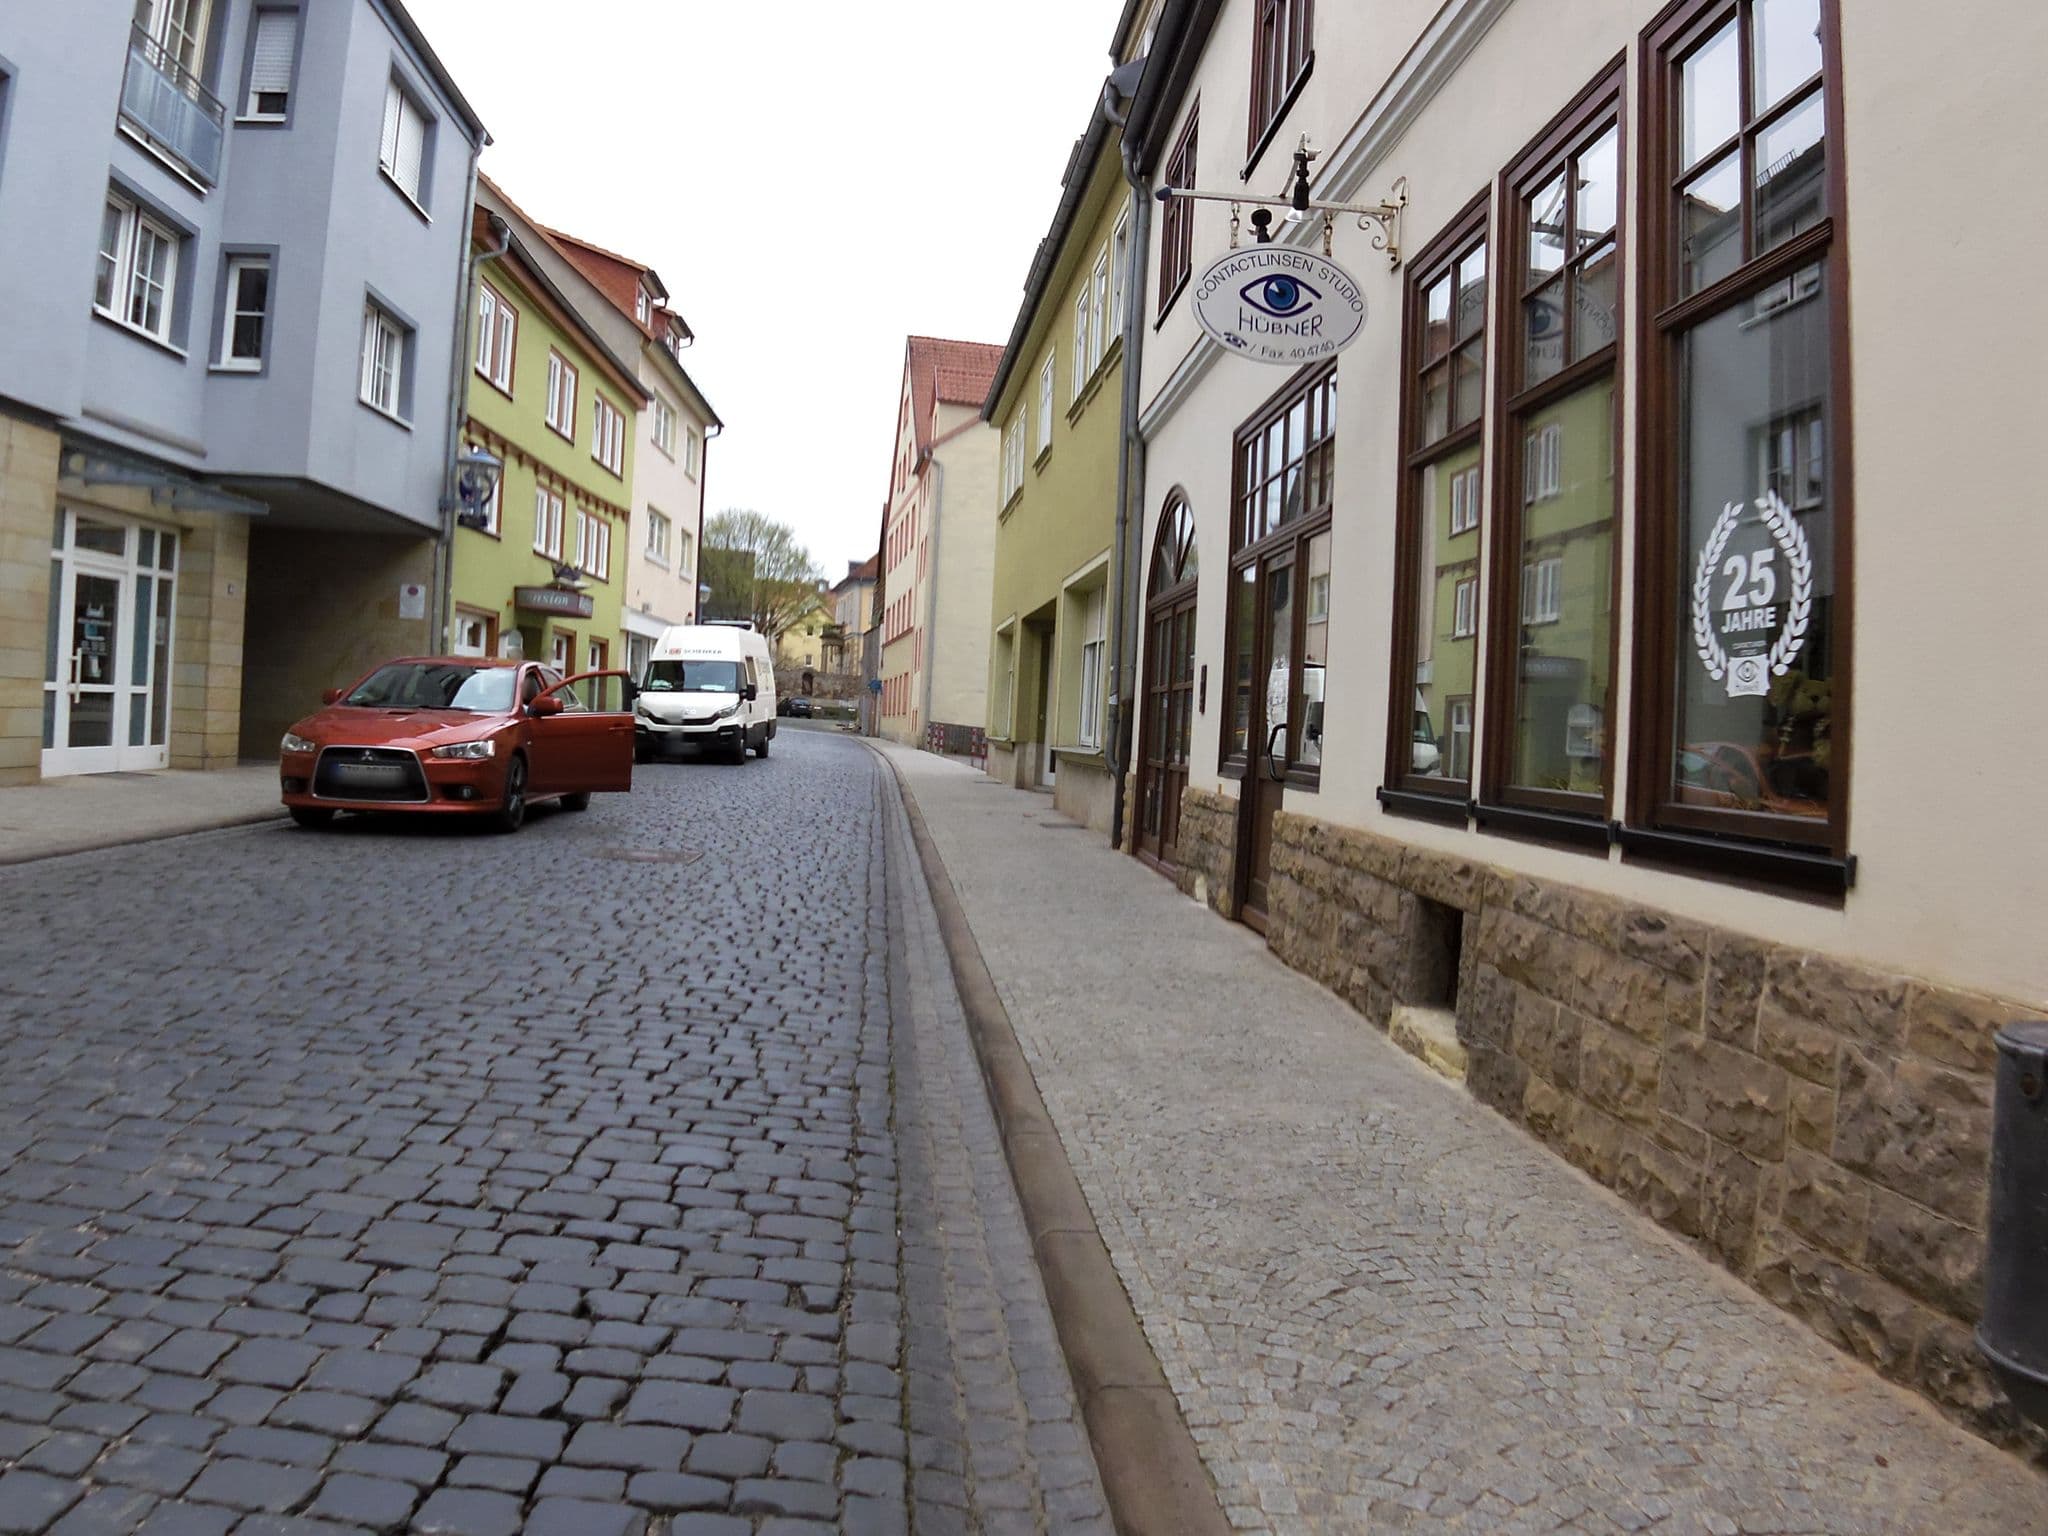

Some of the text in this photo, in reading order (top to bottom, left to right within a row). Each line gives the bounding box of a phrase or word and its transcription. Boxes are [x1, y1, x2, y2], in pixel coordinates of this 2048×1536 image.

[1196, 253, 1364, 313] CONTACTLINSEN STUDIO
[1238, 306, 1323, 337] HÜBNER
[1261, 346, 1285, 359] Fax
[1721, 548, 1776, 611] 25
[1720, 607, 1776, 634] JAHRE
